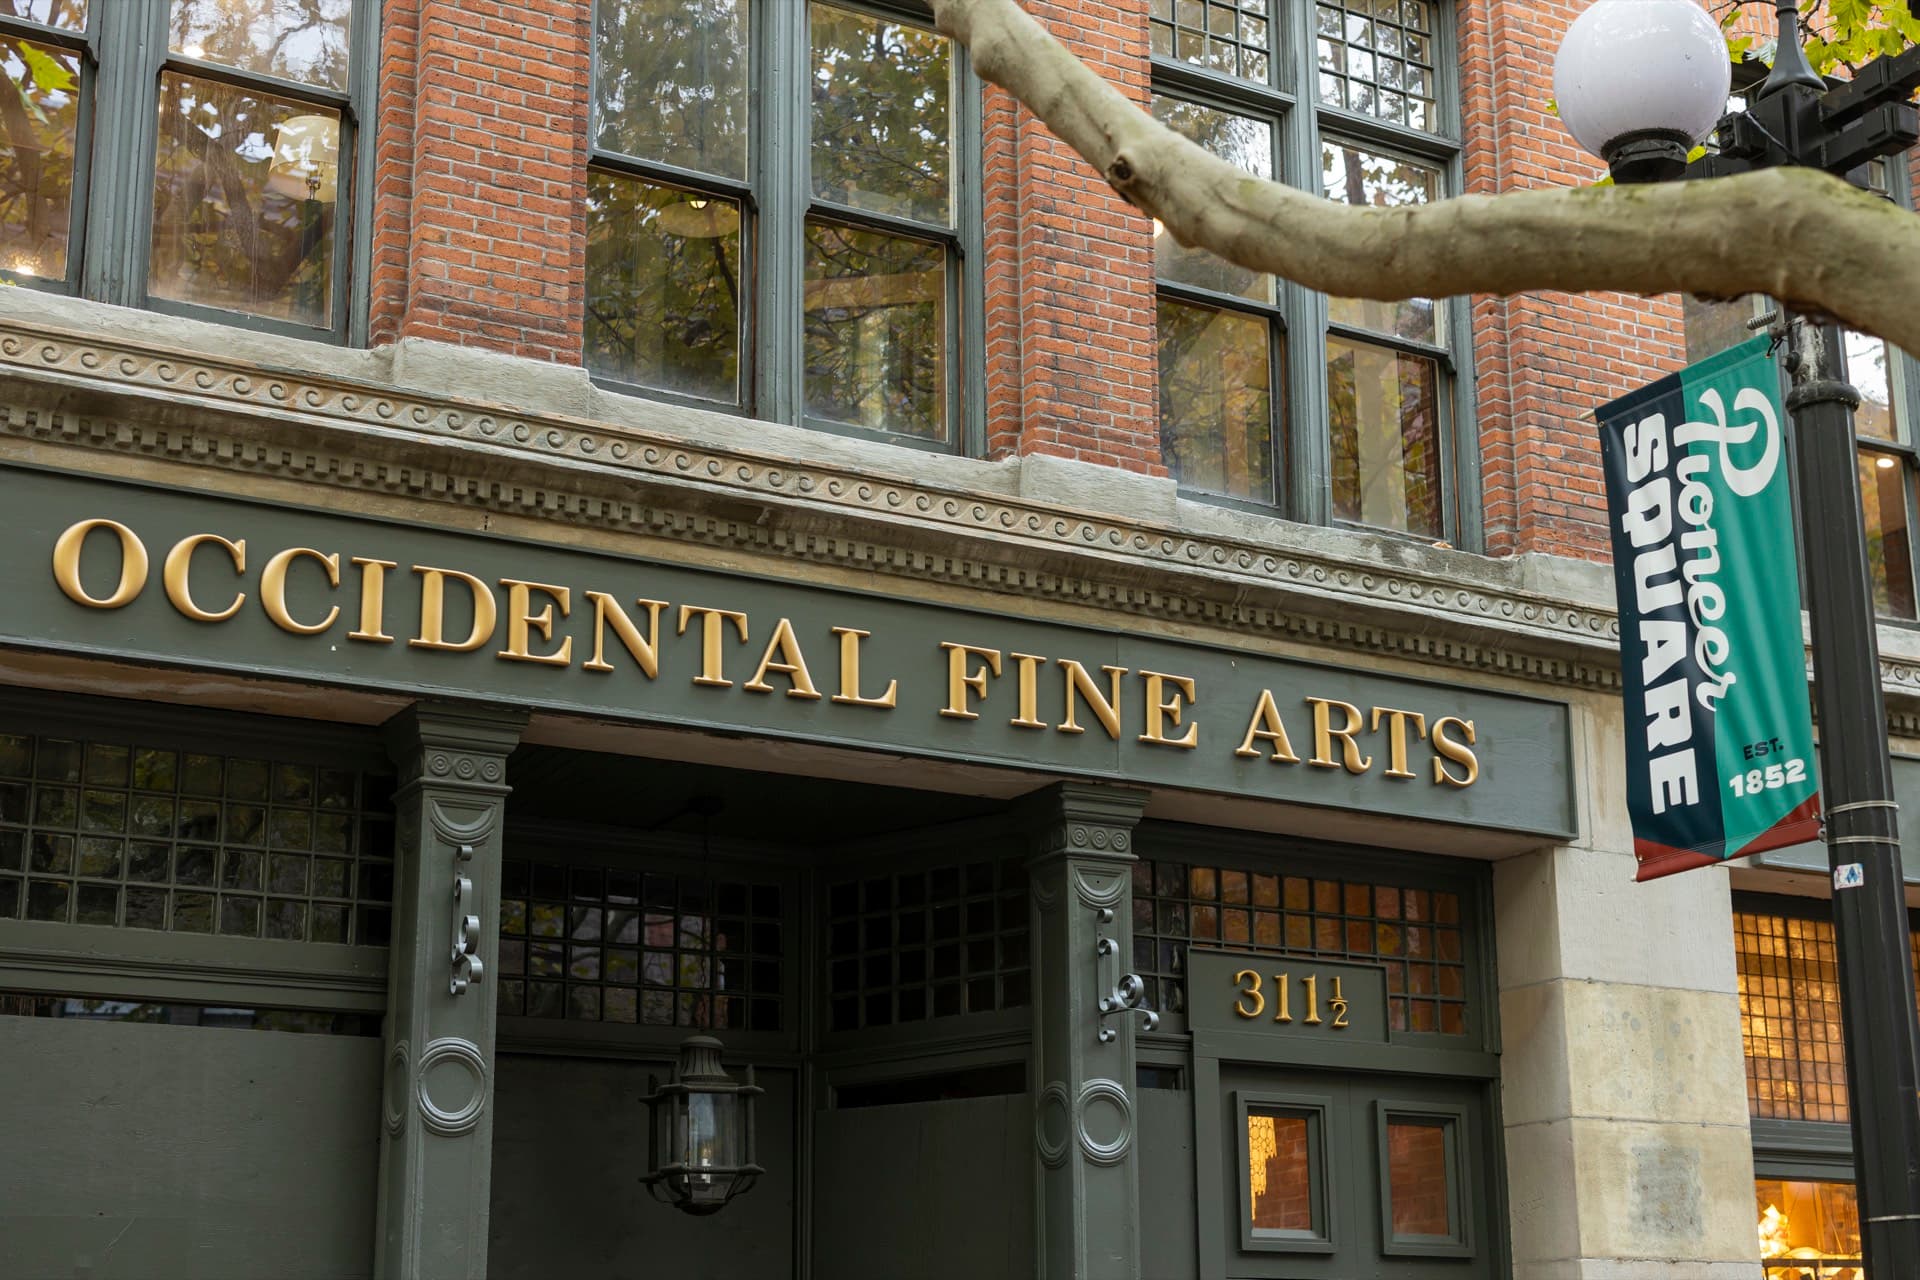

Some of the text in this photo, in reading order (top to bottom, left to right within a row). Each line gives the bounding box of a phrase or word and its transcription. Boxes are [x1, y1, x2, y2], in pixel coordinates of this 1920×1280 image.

[52, 518, 1479, 788] OCCIDENTAL FINE ARTS
[1622, 412, 1700, 815] SQUARE
[1672, 387, 1780, 712] Pioneer
[1728, 757, 1806, 798] 1852
[1742, 737, 1785, 760] EST.
